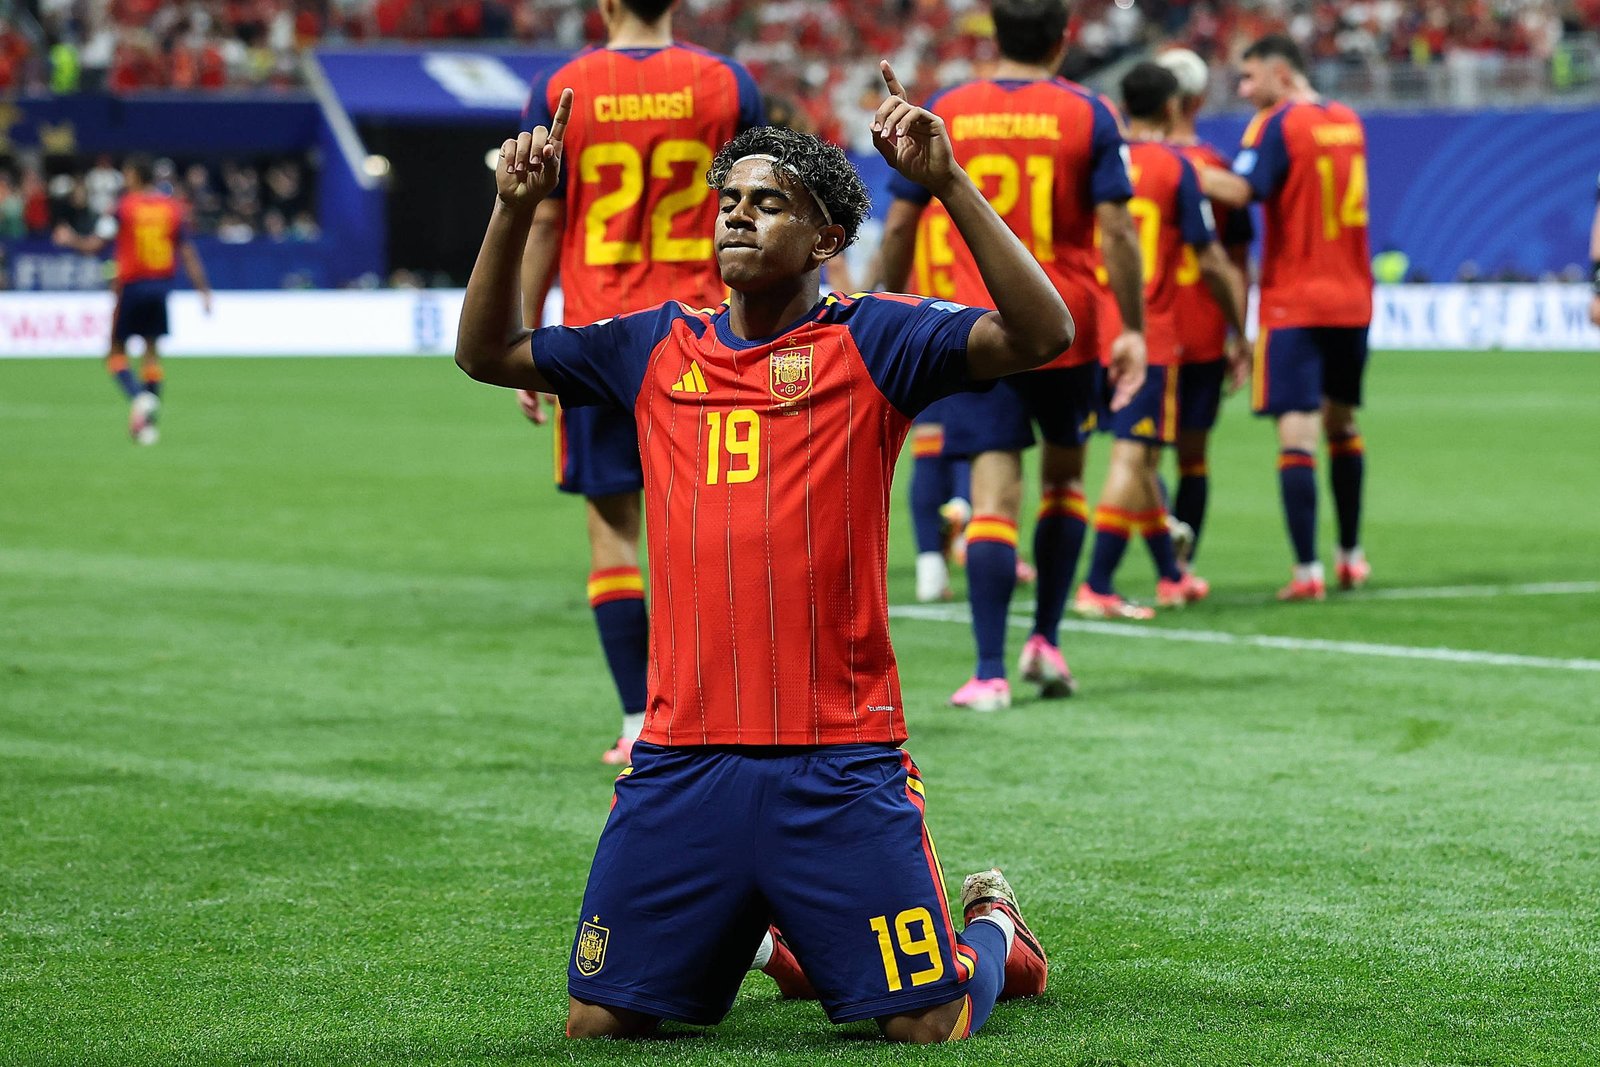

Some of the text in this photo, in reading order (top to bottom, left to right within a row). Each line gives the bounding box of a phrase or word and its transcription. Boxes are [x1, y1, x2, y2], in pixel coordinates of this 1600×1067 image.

[580, 139, 713, 266] 22
[1316, 155, 1369, 241] 14
[707, 409, 760, 485] 19
[869, 907, 945, 993] 19
